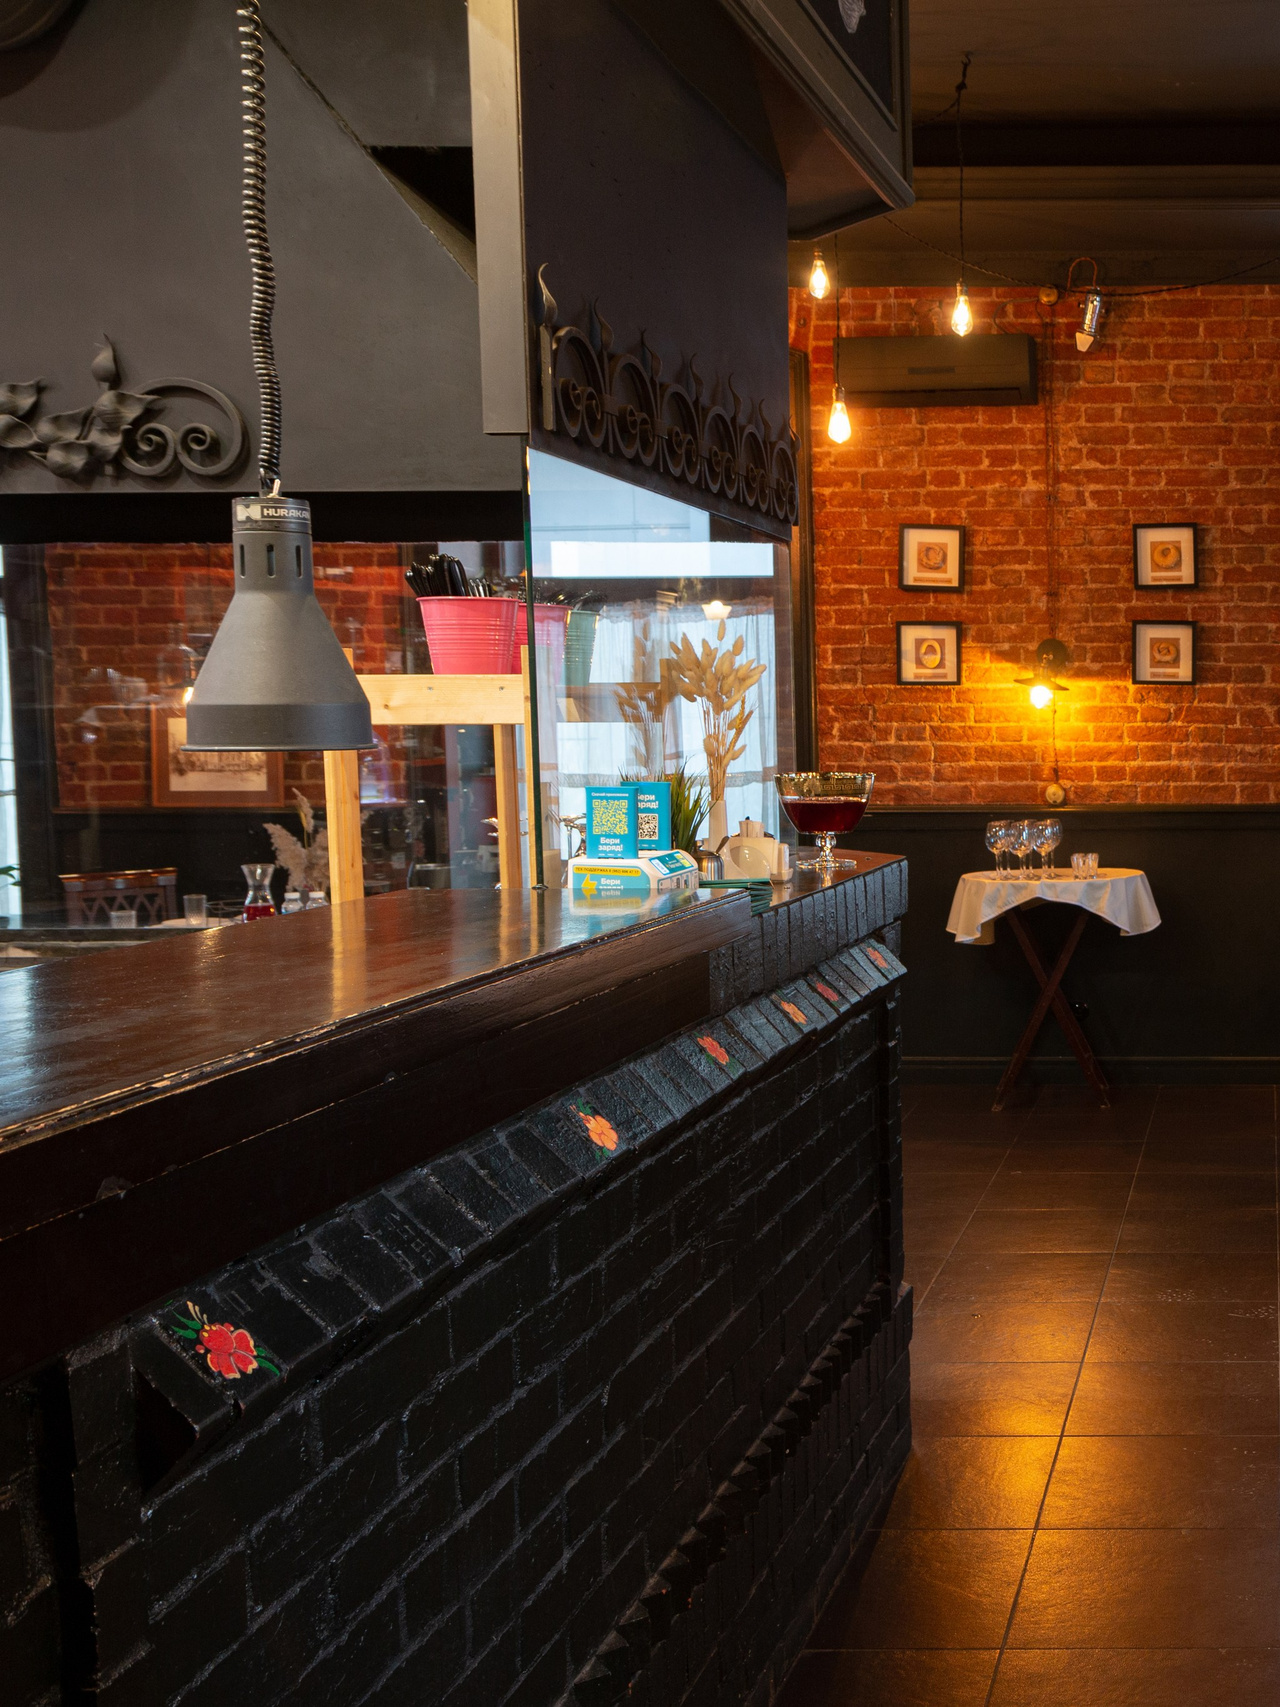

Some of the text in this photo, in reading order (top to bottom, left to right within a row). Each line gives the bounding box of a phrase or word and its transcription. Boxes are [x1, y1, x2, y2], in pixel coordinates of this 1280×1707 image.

[600, 837, 620, 845] Бери
[598, 844, 623, 852] заряд!
[601, 878, 621, 886] Бери
